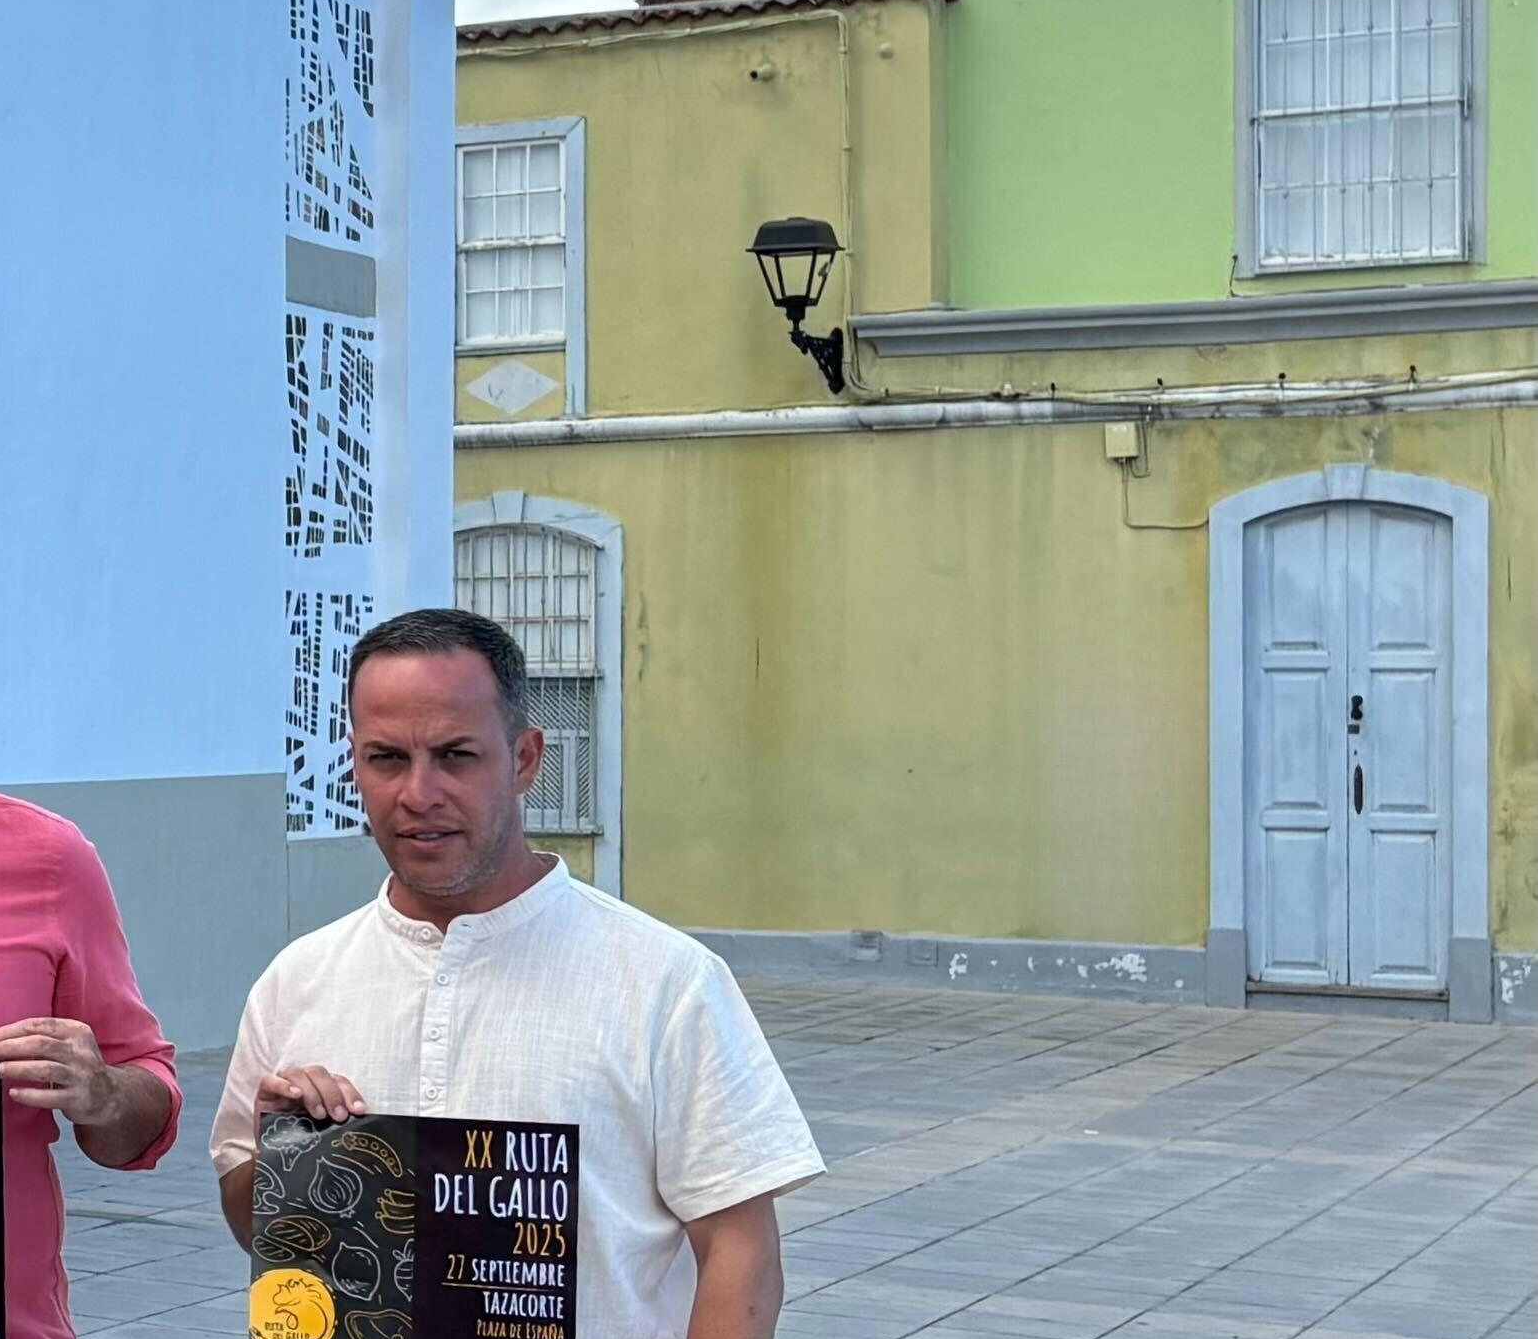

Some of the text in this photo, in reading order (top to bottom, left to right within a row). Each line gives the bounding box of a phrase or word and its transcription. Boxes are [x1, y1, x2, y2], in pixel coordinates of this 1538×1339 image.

[465, 1130, 568, 1173] XX RUTA
[435, 1173, 568, 1221] DEL GALLO
[513, 1222, 566, 1257] 2025
[447, 1254, 564, 1287] 27 SEPTIEMBRE
[483, 1291, 563, 1319] TAZACORTE
